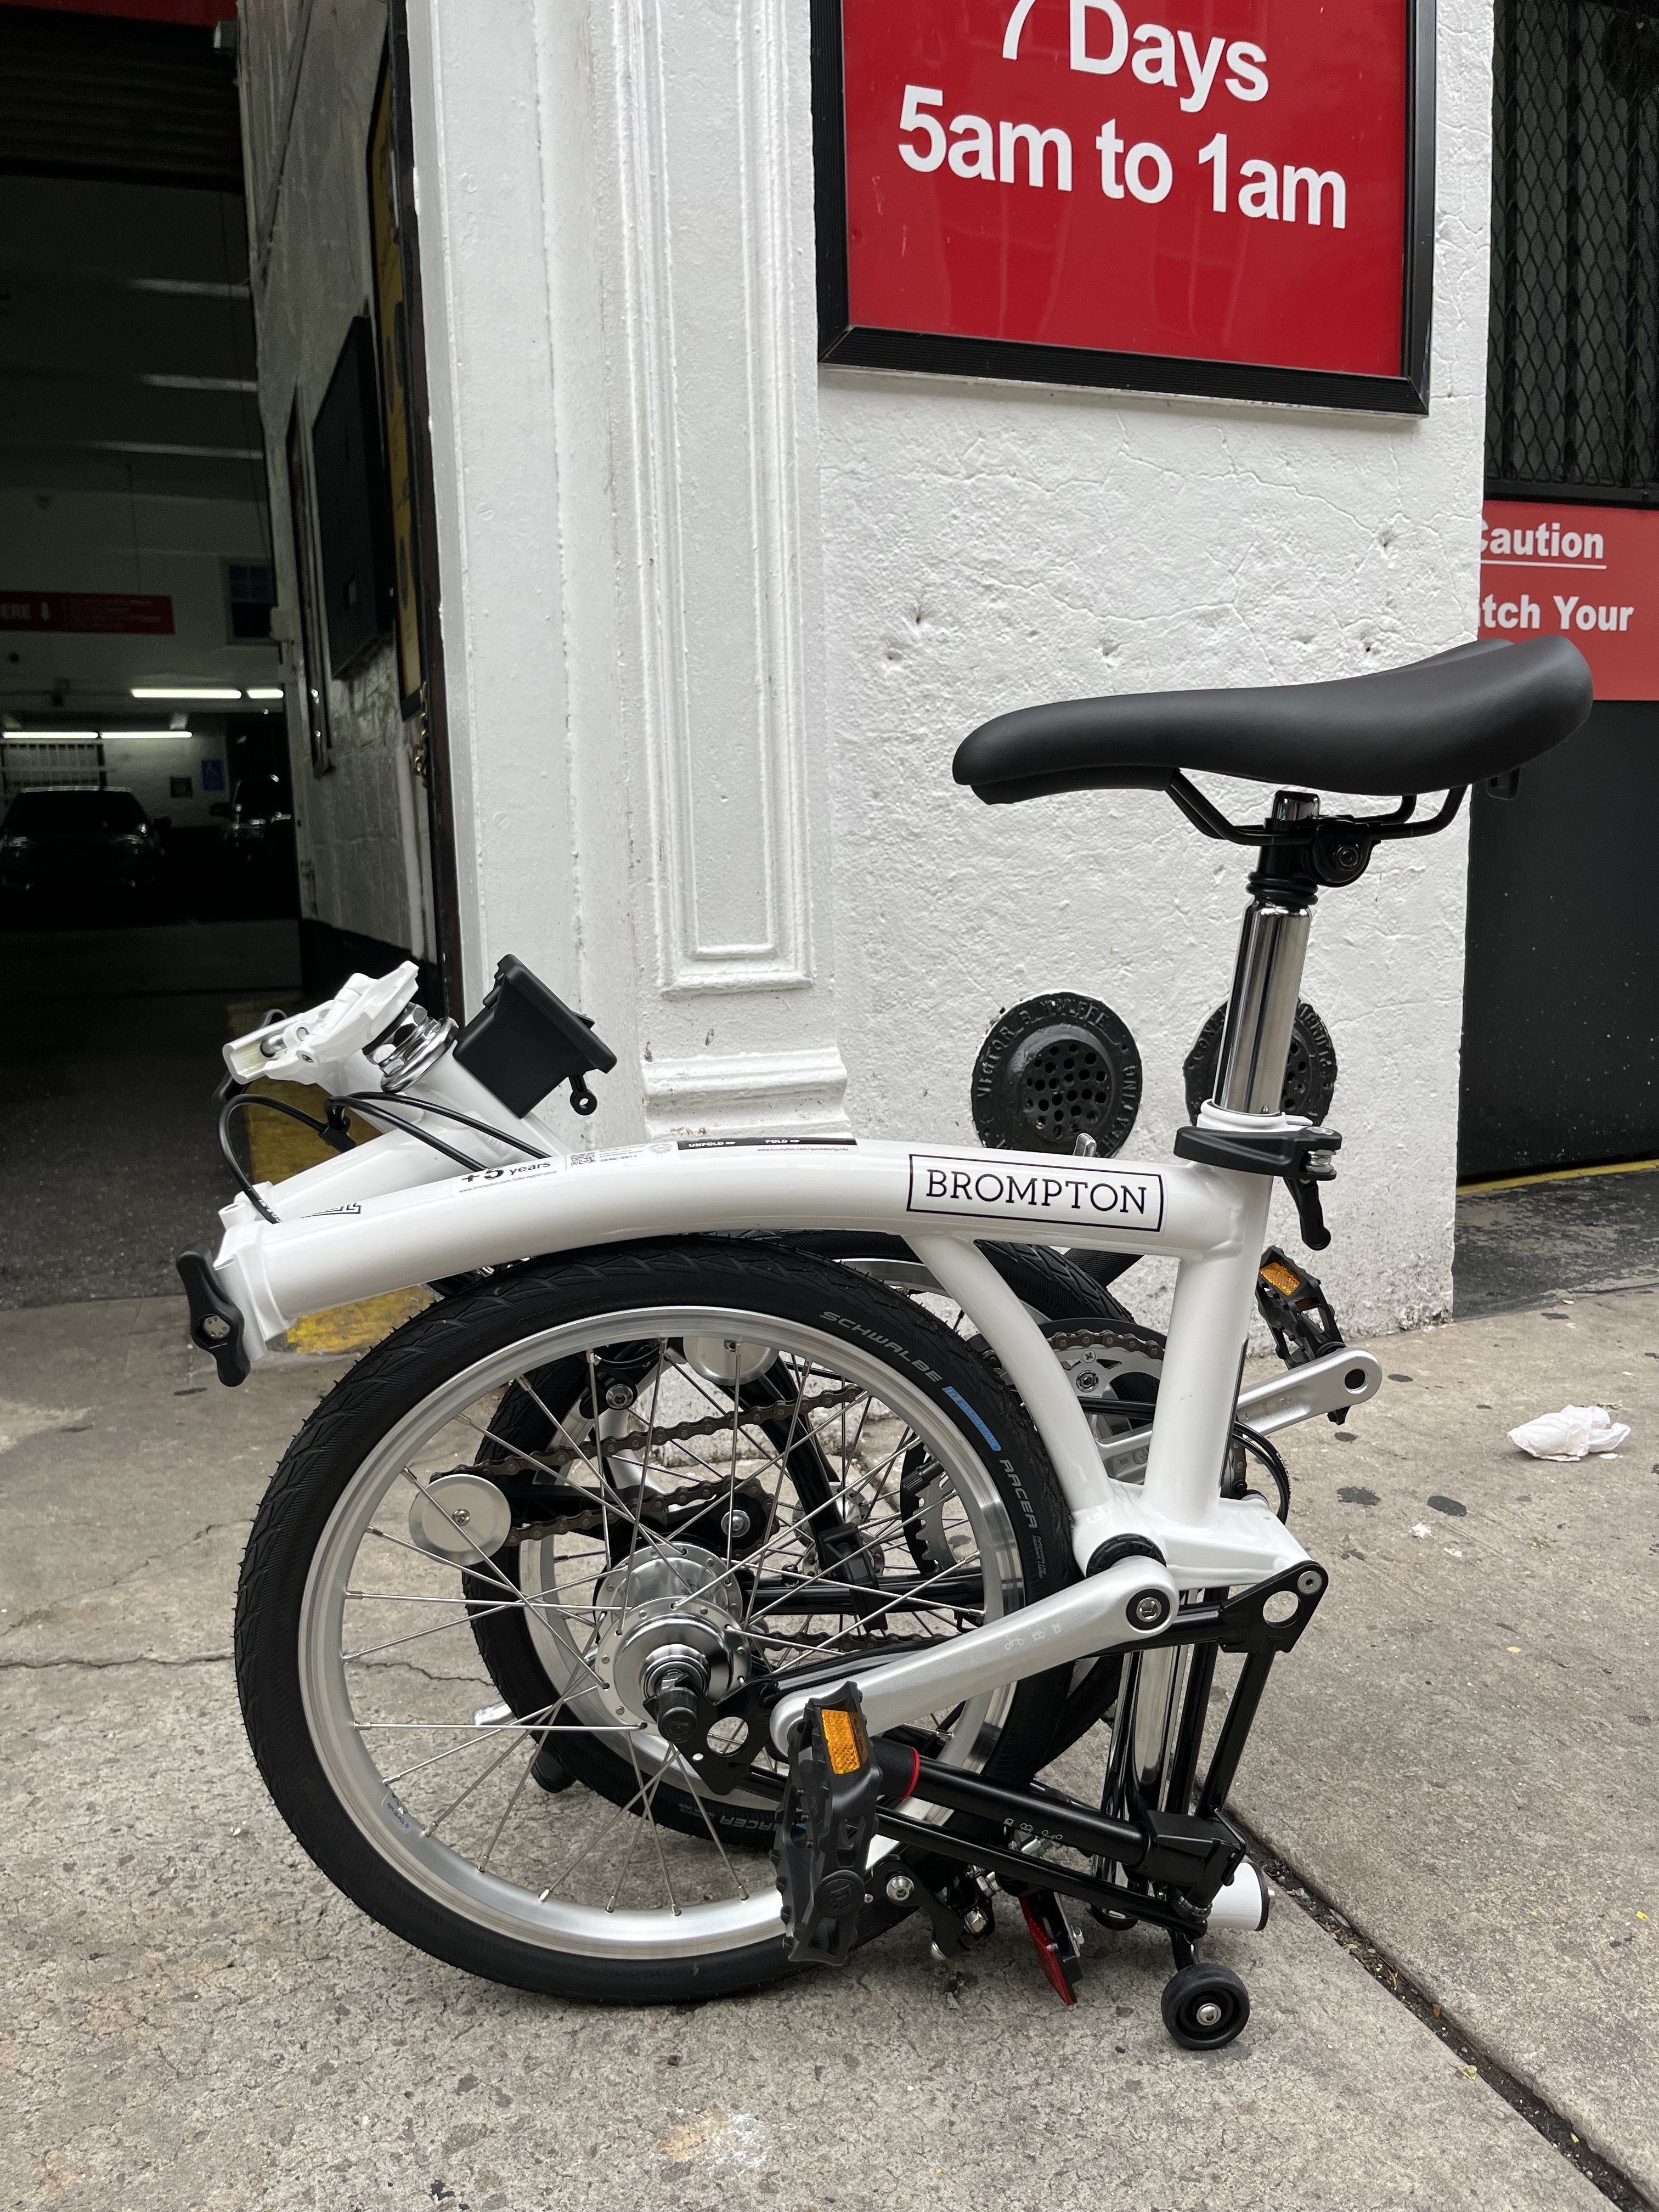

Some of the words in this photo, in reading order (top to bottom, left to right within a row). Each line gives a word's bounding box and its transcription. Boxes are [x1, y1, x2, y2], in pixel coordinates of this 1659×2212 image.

[1070, 0, 1269, 112] Days
[899, 85, 1072, 191] 5am
[1096, 119, 1173, 204] to
[1198, 133, 1346, 229] 1am
[1479, 594, 1541, 629] tch
[1553, 595, 1634, 631] Your
[509, 1161, 551, 1176] years
[926, 1169, 1147, 1214] BROMPTON
[820, 1311, 943, 1382] SCHWALBE
[1000, 1459, 1038, 1529] RACER
